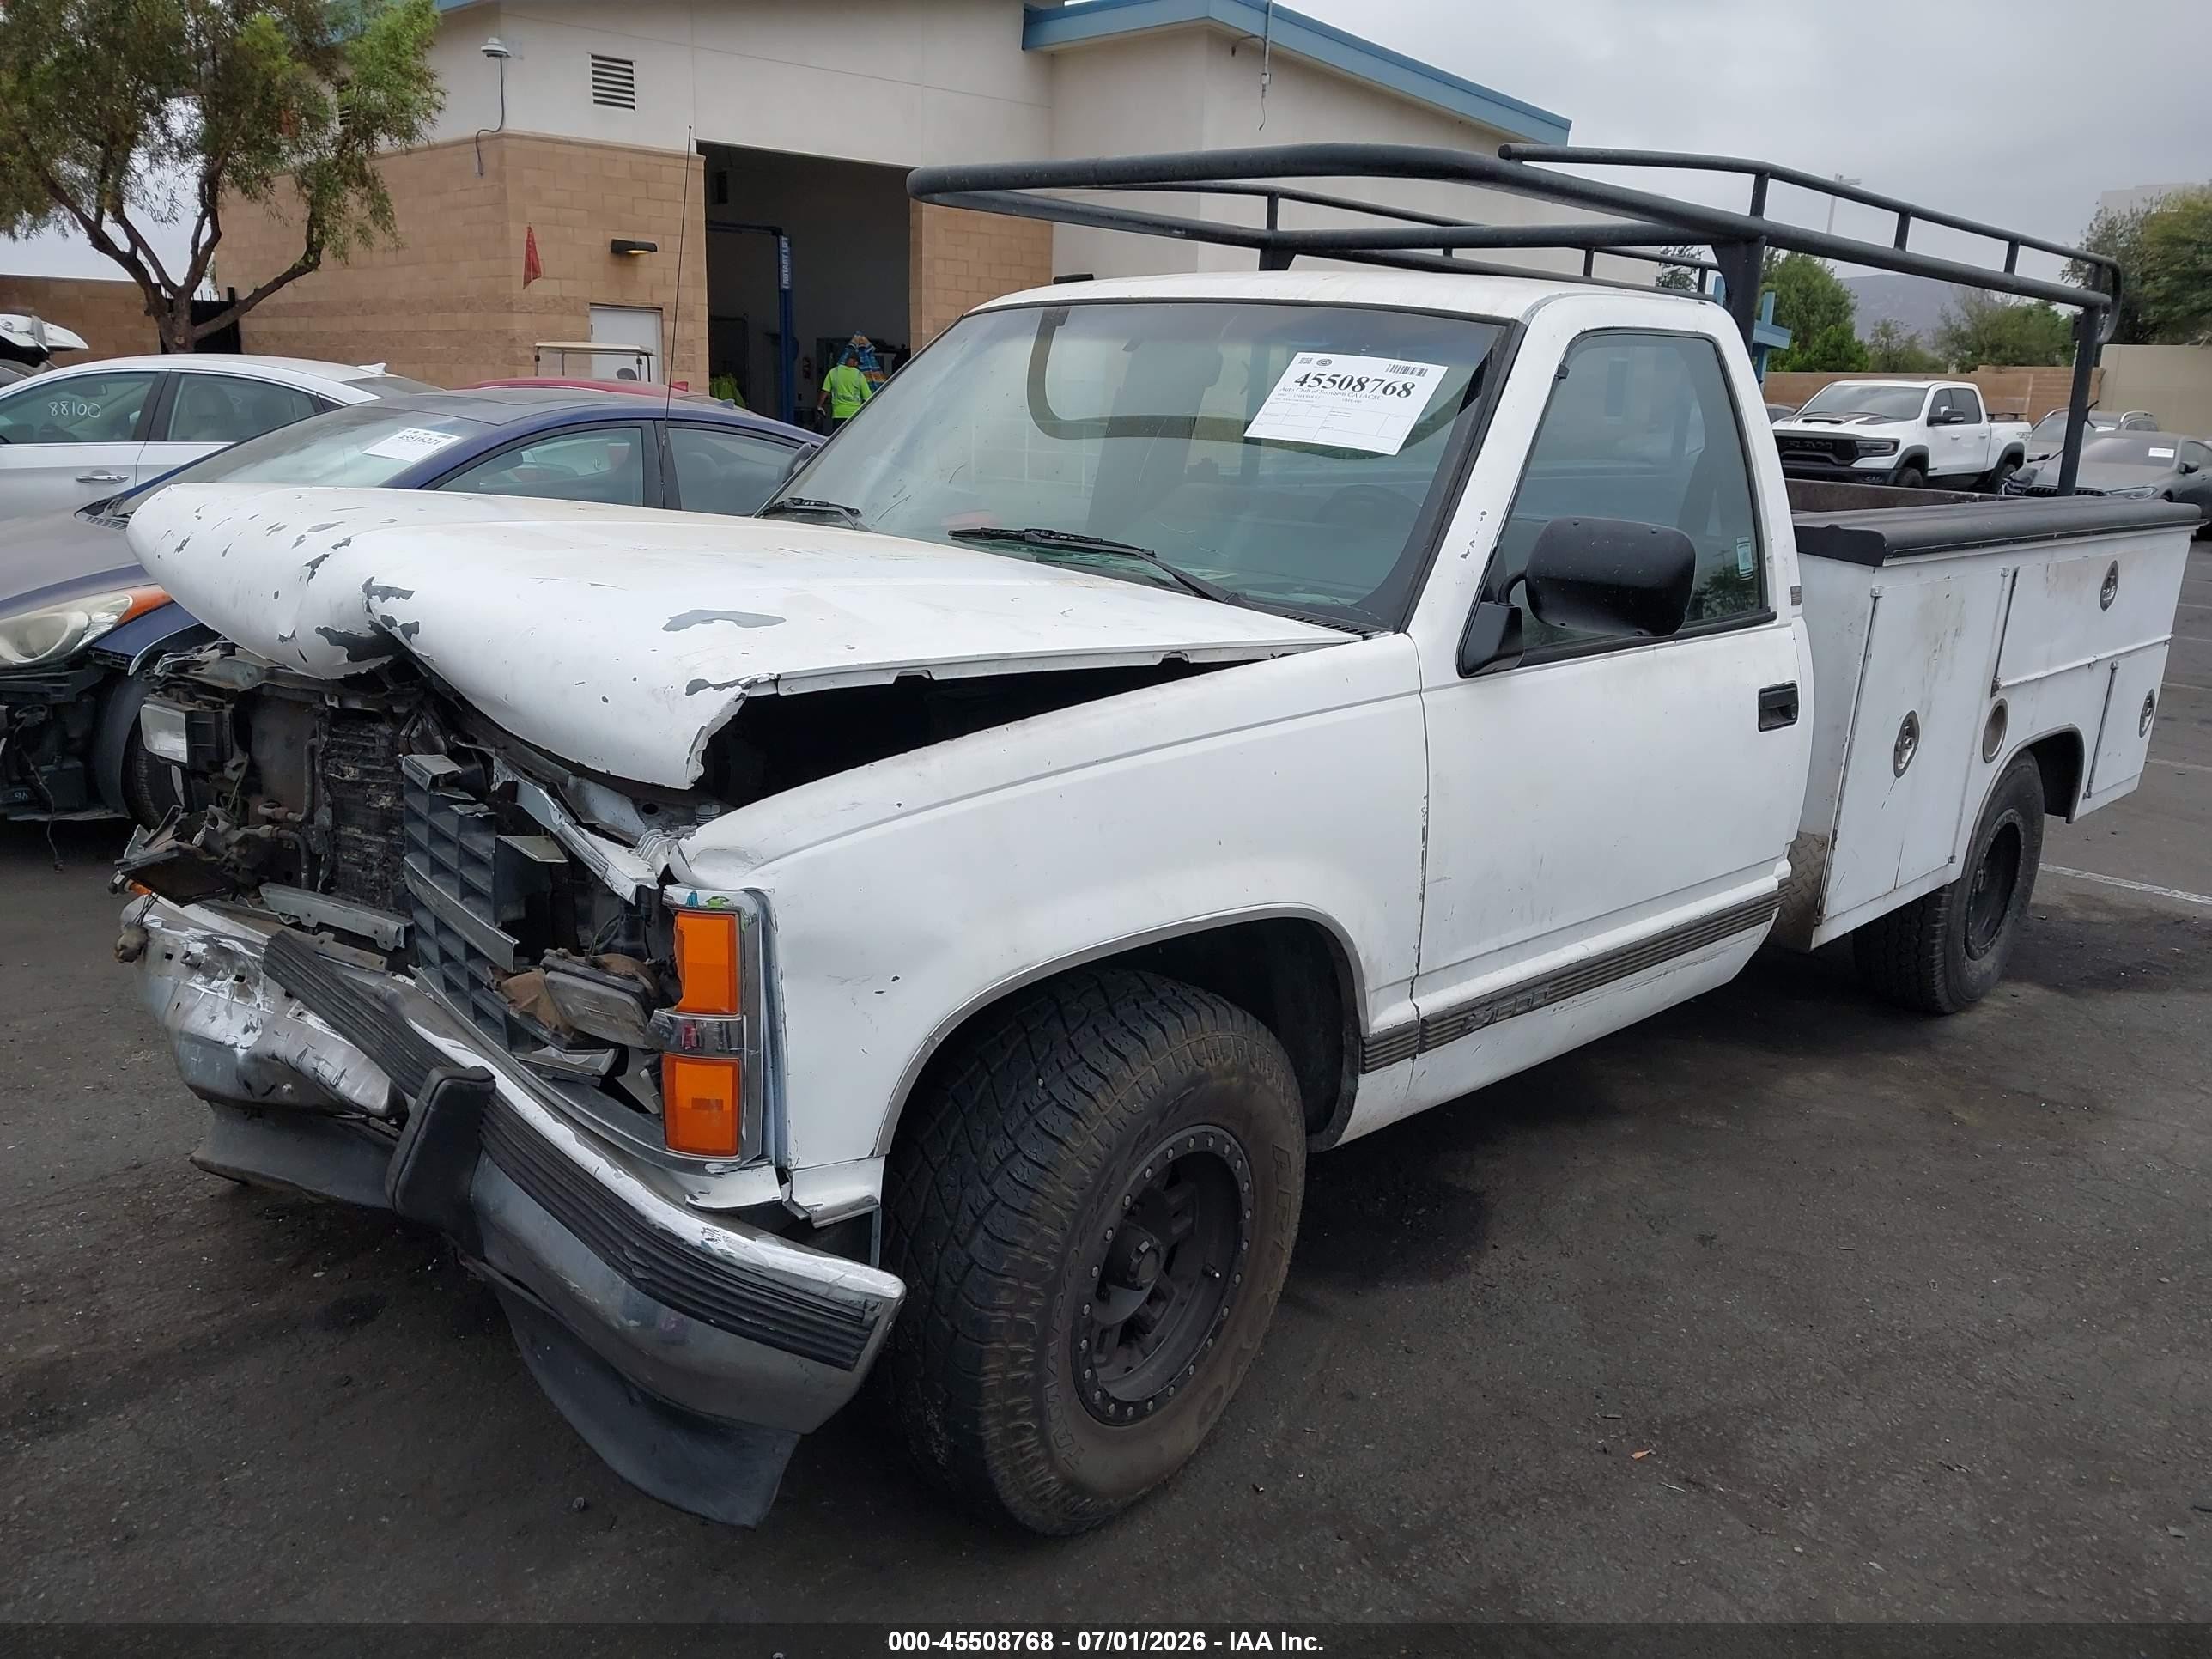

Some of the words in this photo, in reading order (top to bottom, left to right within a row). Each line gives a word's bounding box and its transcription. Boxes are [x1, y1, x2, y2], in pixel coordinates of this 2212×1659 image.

[1294, 371, 1416, 399] 45508768
[1320, 388, 1346, 397] Southern
[48, 401, 101, 418] 88100
